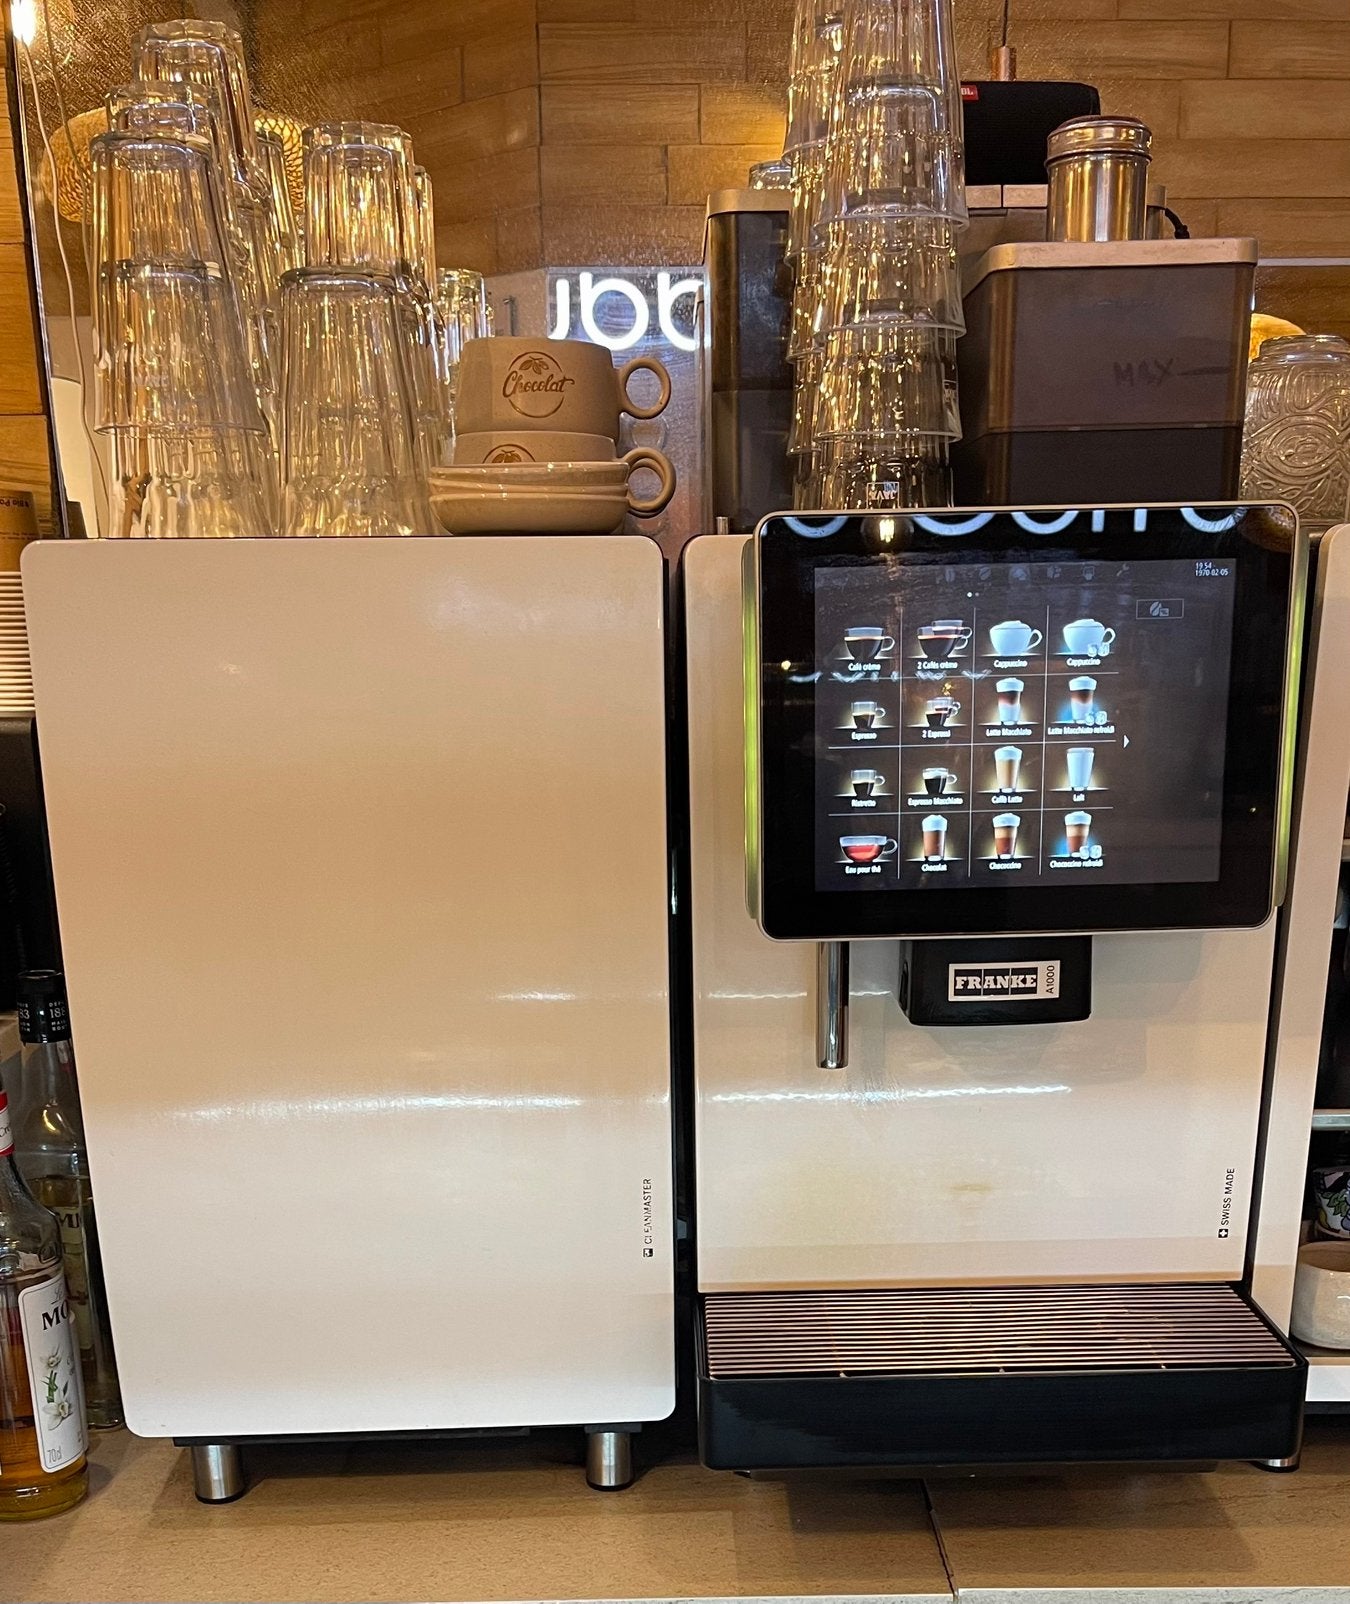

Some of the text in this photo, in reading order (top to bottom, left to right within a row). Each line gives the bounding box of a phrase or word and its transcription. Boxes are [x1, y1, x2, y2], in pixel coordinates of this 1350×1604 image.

[502, 370, 575, 398] Chocolat
[993, 660, 1028, 668] Cappuccino
[1066, 658, 1101, 667] Cappuccino
[985, 728, 1032, 736] Latte Macchiato
[1048, 727, 1063, 735] Latte
[1063, 726, 1093, 735] Macchiato
[851, 732, 877, 740] Espresso
[908, 797, 963, 806] Espresso Macchiato
[1008, 795, 1023, 803] Latte
[1073, 794, 1085, 802] Lait
[845, 866, 856, 874] Eau
[856, 866, 871, 874] pour
[921, 864, 948, 872] Chocolat
[955, 974, 1037, 990] FRANKE
[1045, 964, 1056, 995] A1000
[1220, 1167, 1236, 1226] SWISS MADE
[642, 1178, 653, 1245] CLEANMASTER
